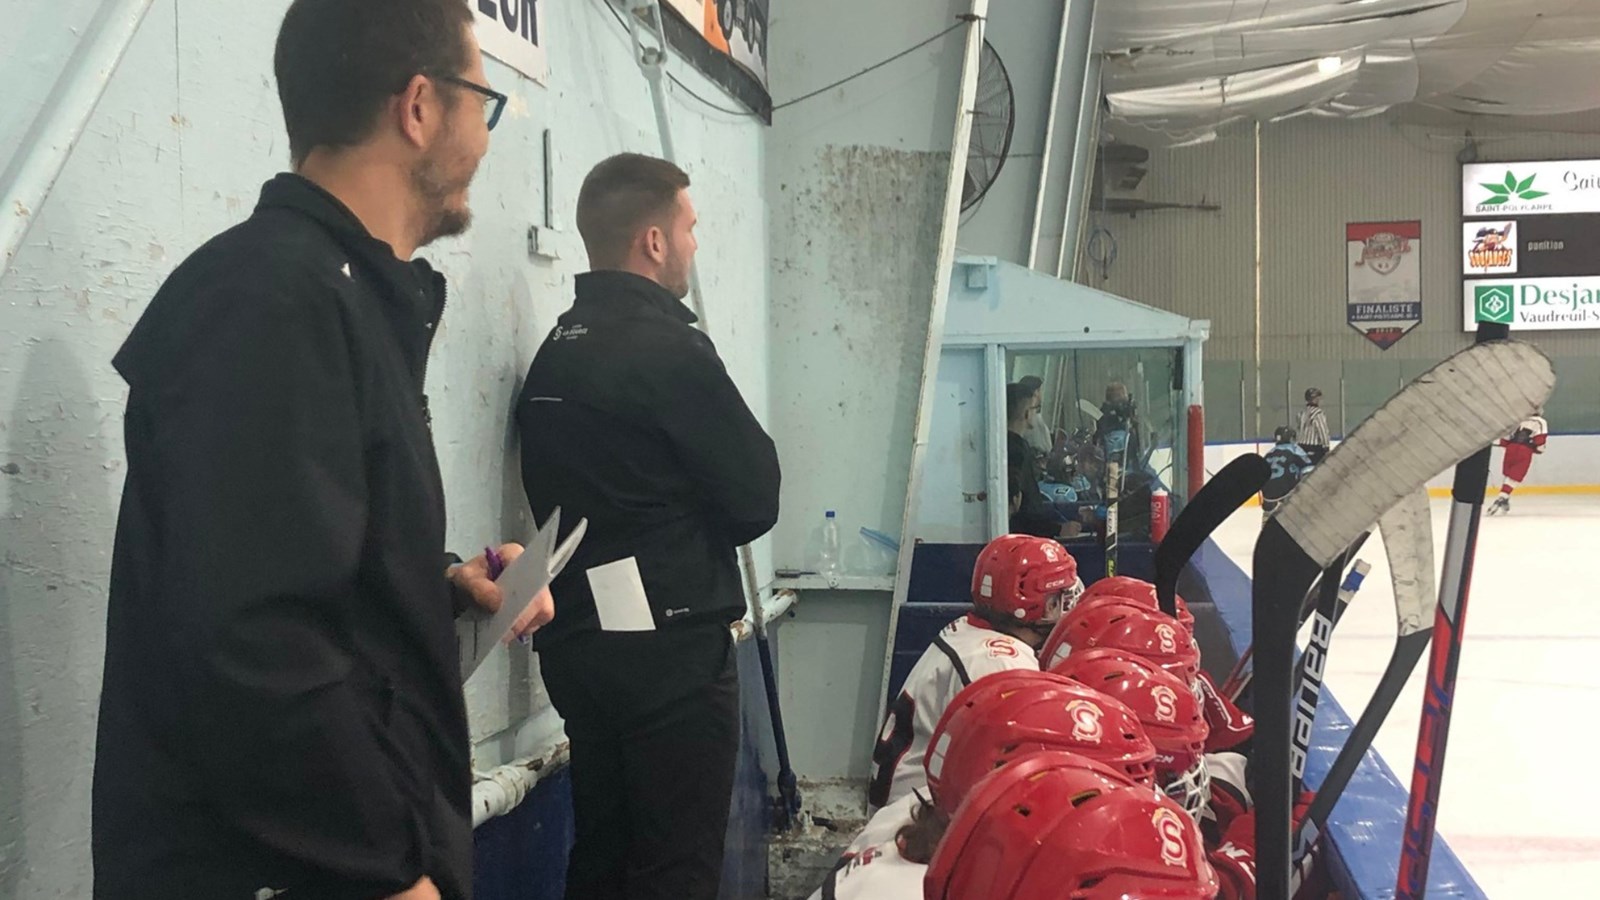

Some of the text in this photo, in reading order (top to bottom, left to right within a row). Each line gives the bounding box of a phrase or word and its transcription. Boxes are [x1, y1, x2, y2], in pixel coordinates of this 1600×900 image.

[1356, 303, 1413, 314] FINALISTE
[1290, 609, 1332, 779] BAUER
[1153, 808, 1187, 868] S
